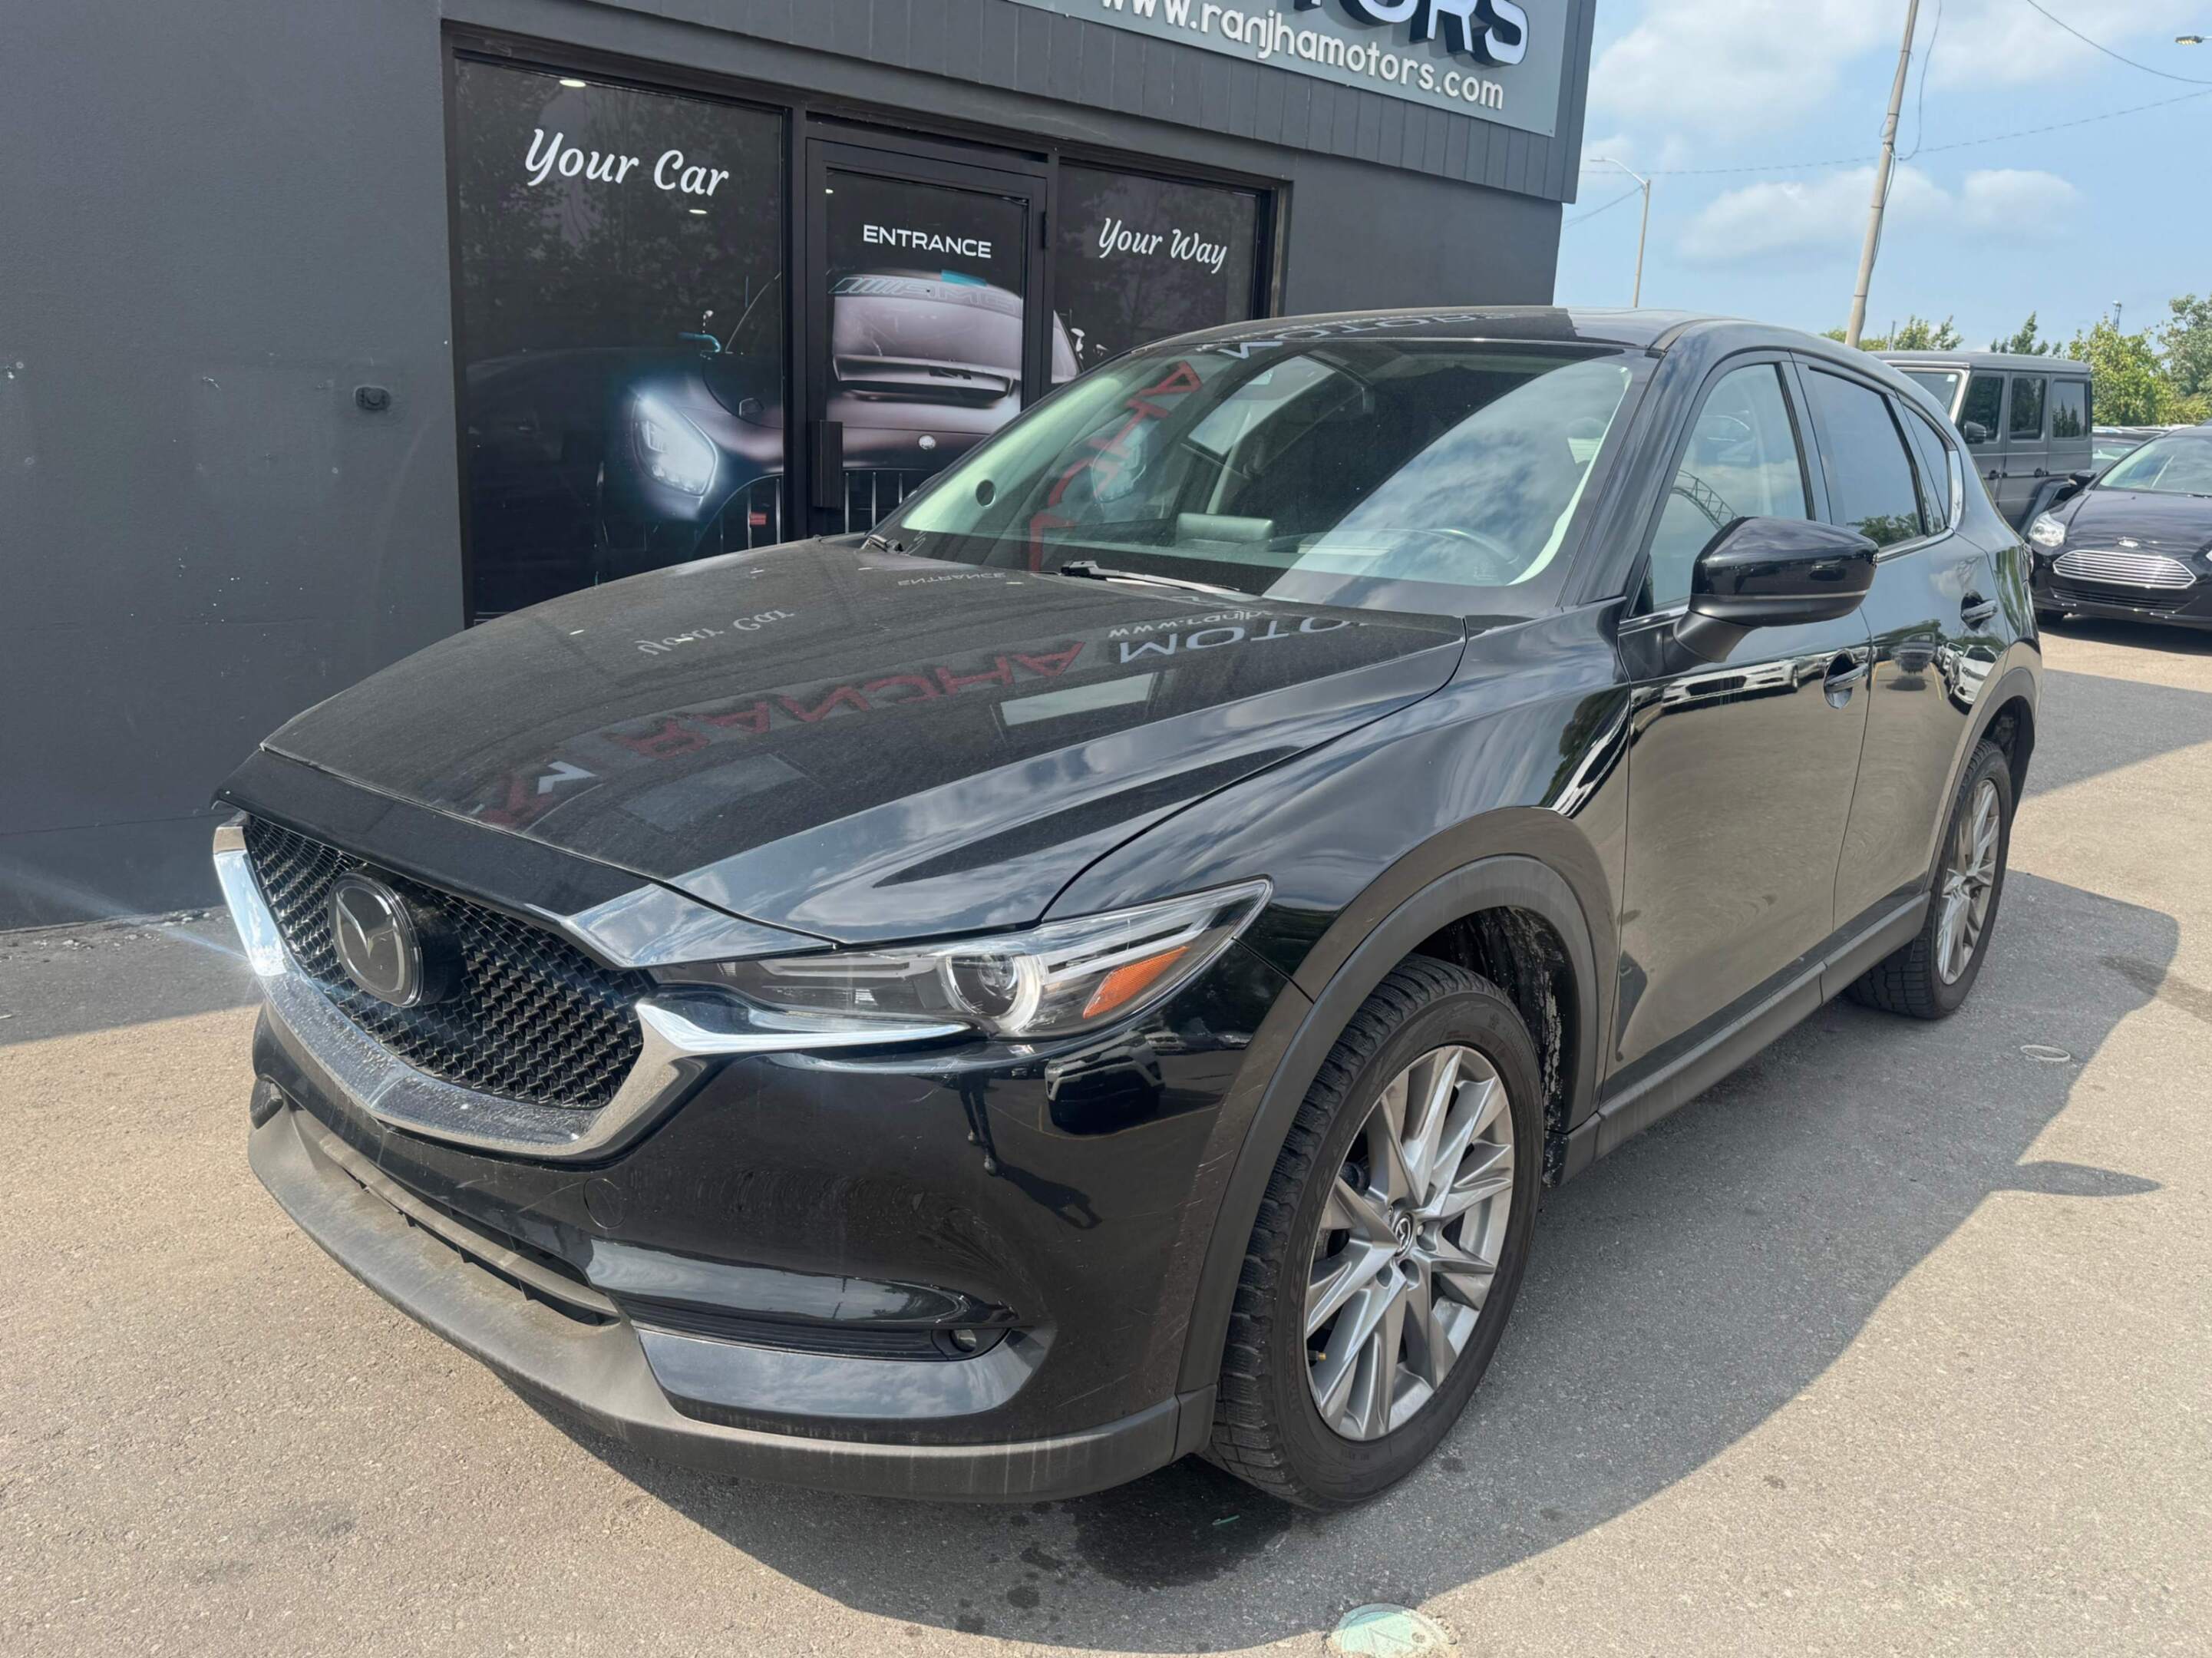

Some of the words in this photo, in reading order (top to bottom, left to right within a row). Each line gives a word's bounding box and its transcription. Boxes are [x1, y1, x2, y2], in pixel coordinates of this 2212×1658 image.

[1294, 0, 1529, 64] RS
[525, 128, 639, 187] Your
[654, 150, 729, 197] Car
[863, 224, 992, 259] ENTRANCE
[1098, 217, 1164, 259] Your
[1170, 229, 1227, 274] Way
